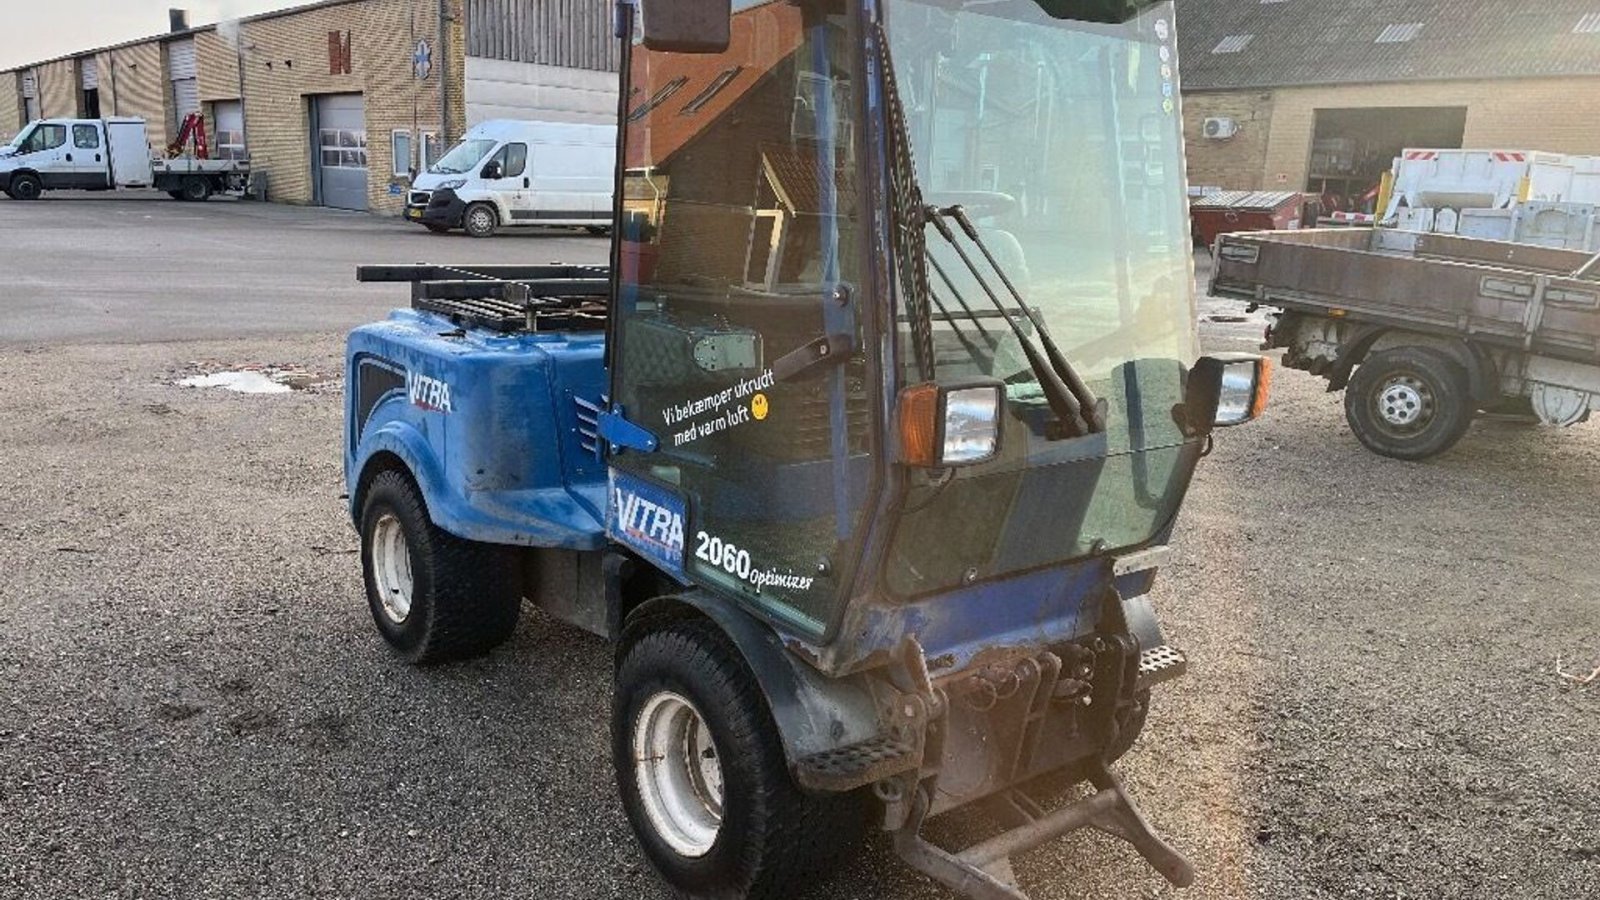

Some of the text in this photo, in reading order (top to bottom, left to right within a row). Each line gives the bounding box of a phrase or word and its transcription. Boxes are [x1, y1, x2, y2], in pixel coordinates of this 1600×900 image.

[407, 369, 452, 413] VITRA
[662, 368, 775, 426] Vi bekæmper ukrudt
[673, 404, 750, 447] med varm luft
[616, 488, 684, 550] VITRA
[695, 531, 750, 579] 2060
